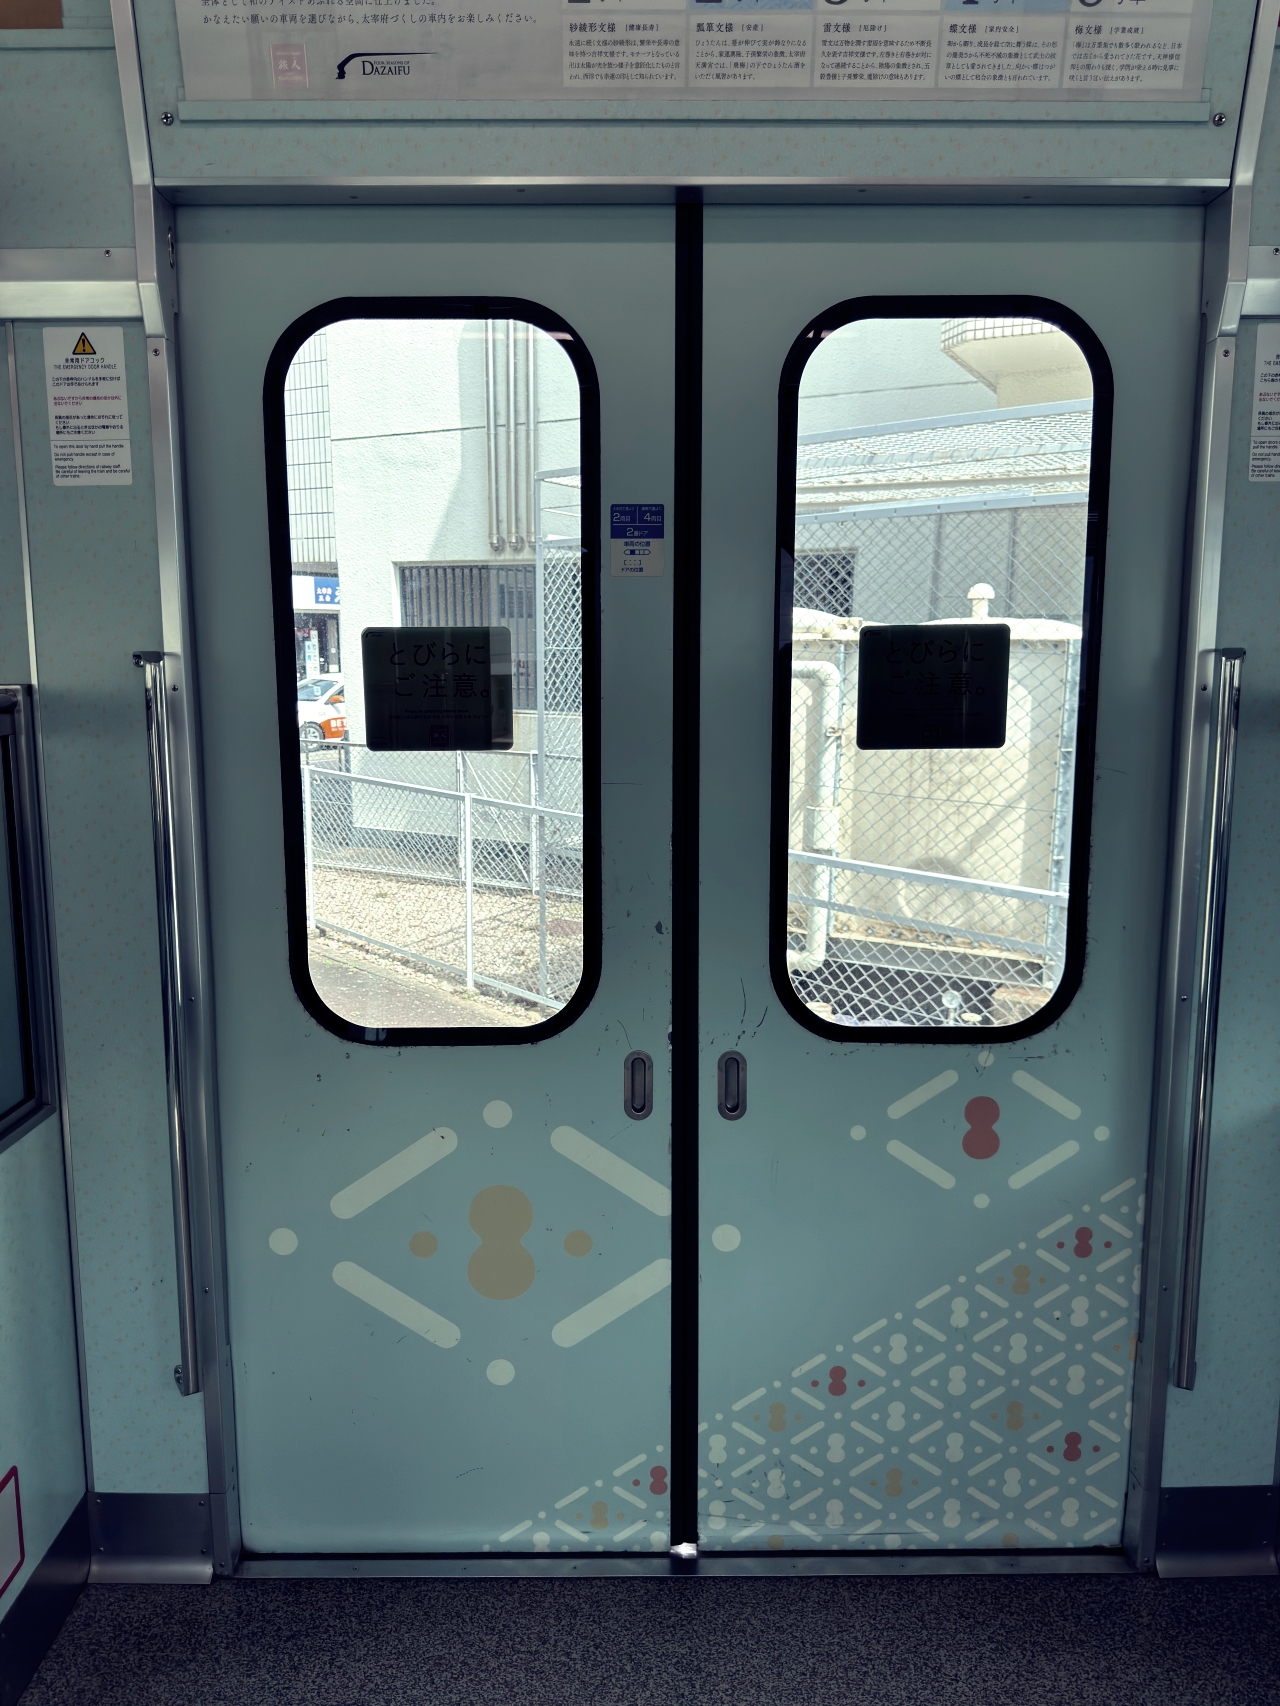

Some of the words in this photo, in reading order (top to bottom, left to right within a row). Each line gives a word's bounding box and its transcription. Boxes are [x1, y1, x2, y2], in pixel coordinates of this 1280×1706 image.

[203, 13, 537, 24] かなえたい願いの車両を選びながら、太宰府づくしの車内をお楽しみください。
[569, 22, 616, 33] 紗綾形文様
[823, 22, 851, 33] 雷文様
[949, 24, 977, 34] 蝶文様
[1075, 25, 1102, 35] 梅文様
[362, 60, 410, 75] DAZAIFU
[613, 512, 631, 522] 2両目
[644, 512, 662, 522] 4両目
[626, 528, 648, 536] 2番ドア
[390, 642, 487, 666] とびらに
[886, 640, 984, 664] とびらに
[394, 672, 490, 698] ご注意。
[888, 671, 985, 696] ご注意。
